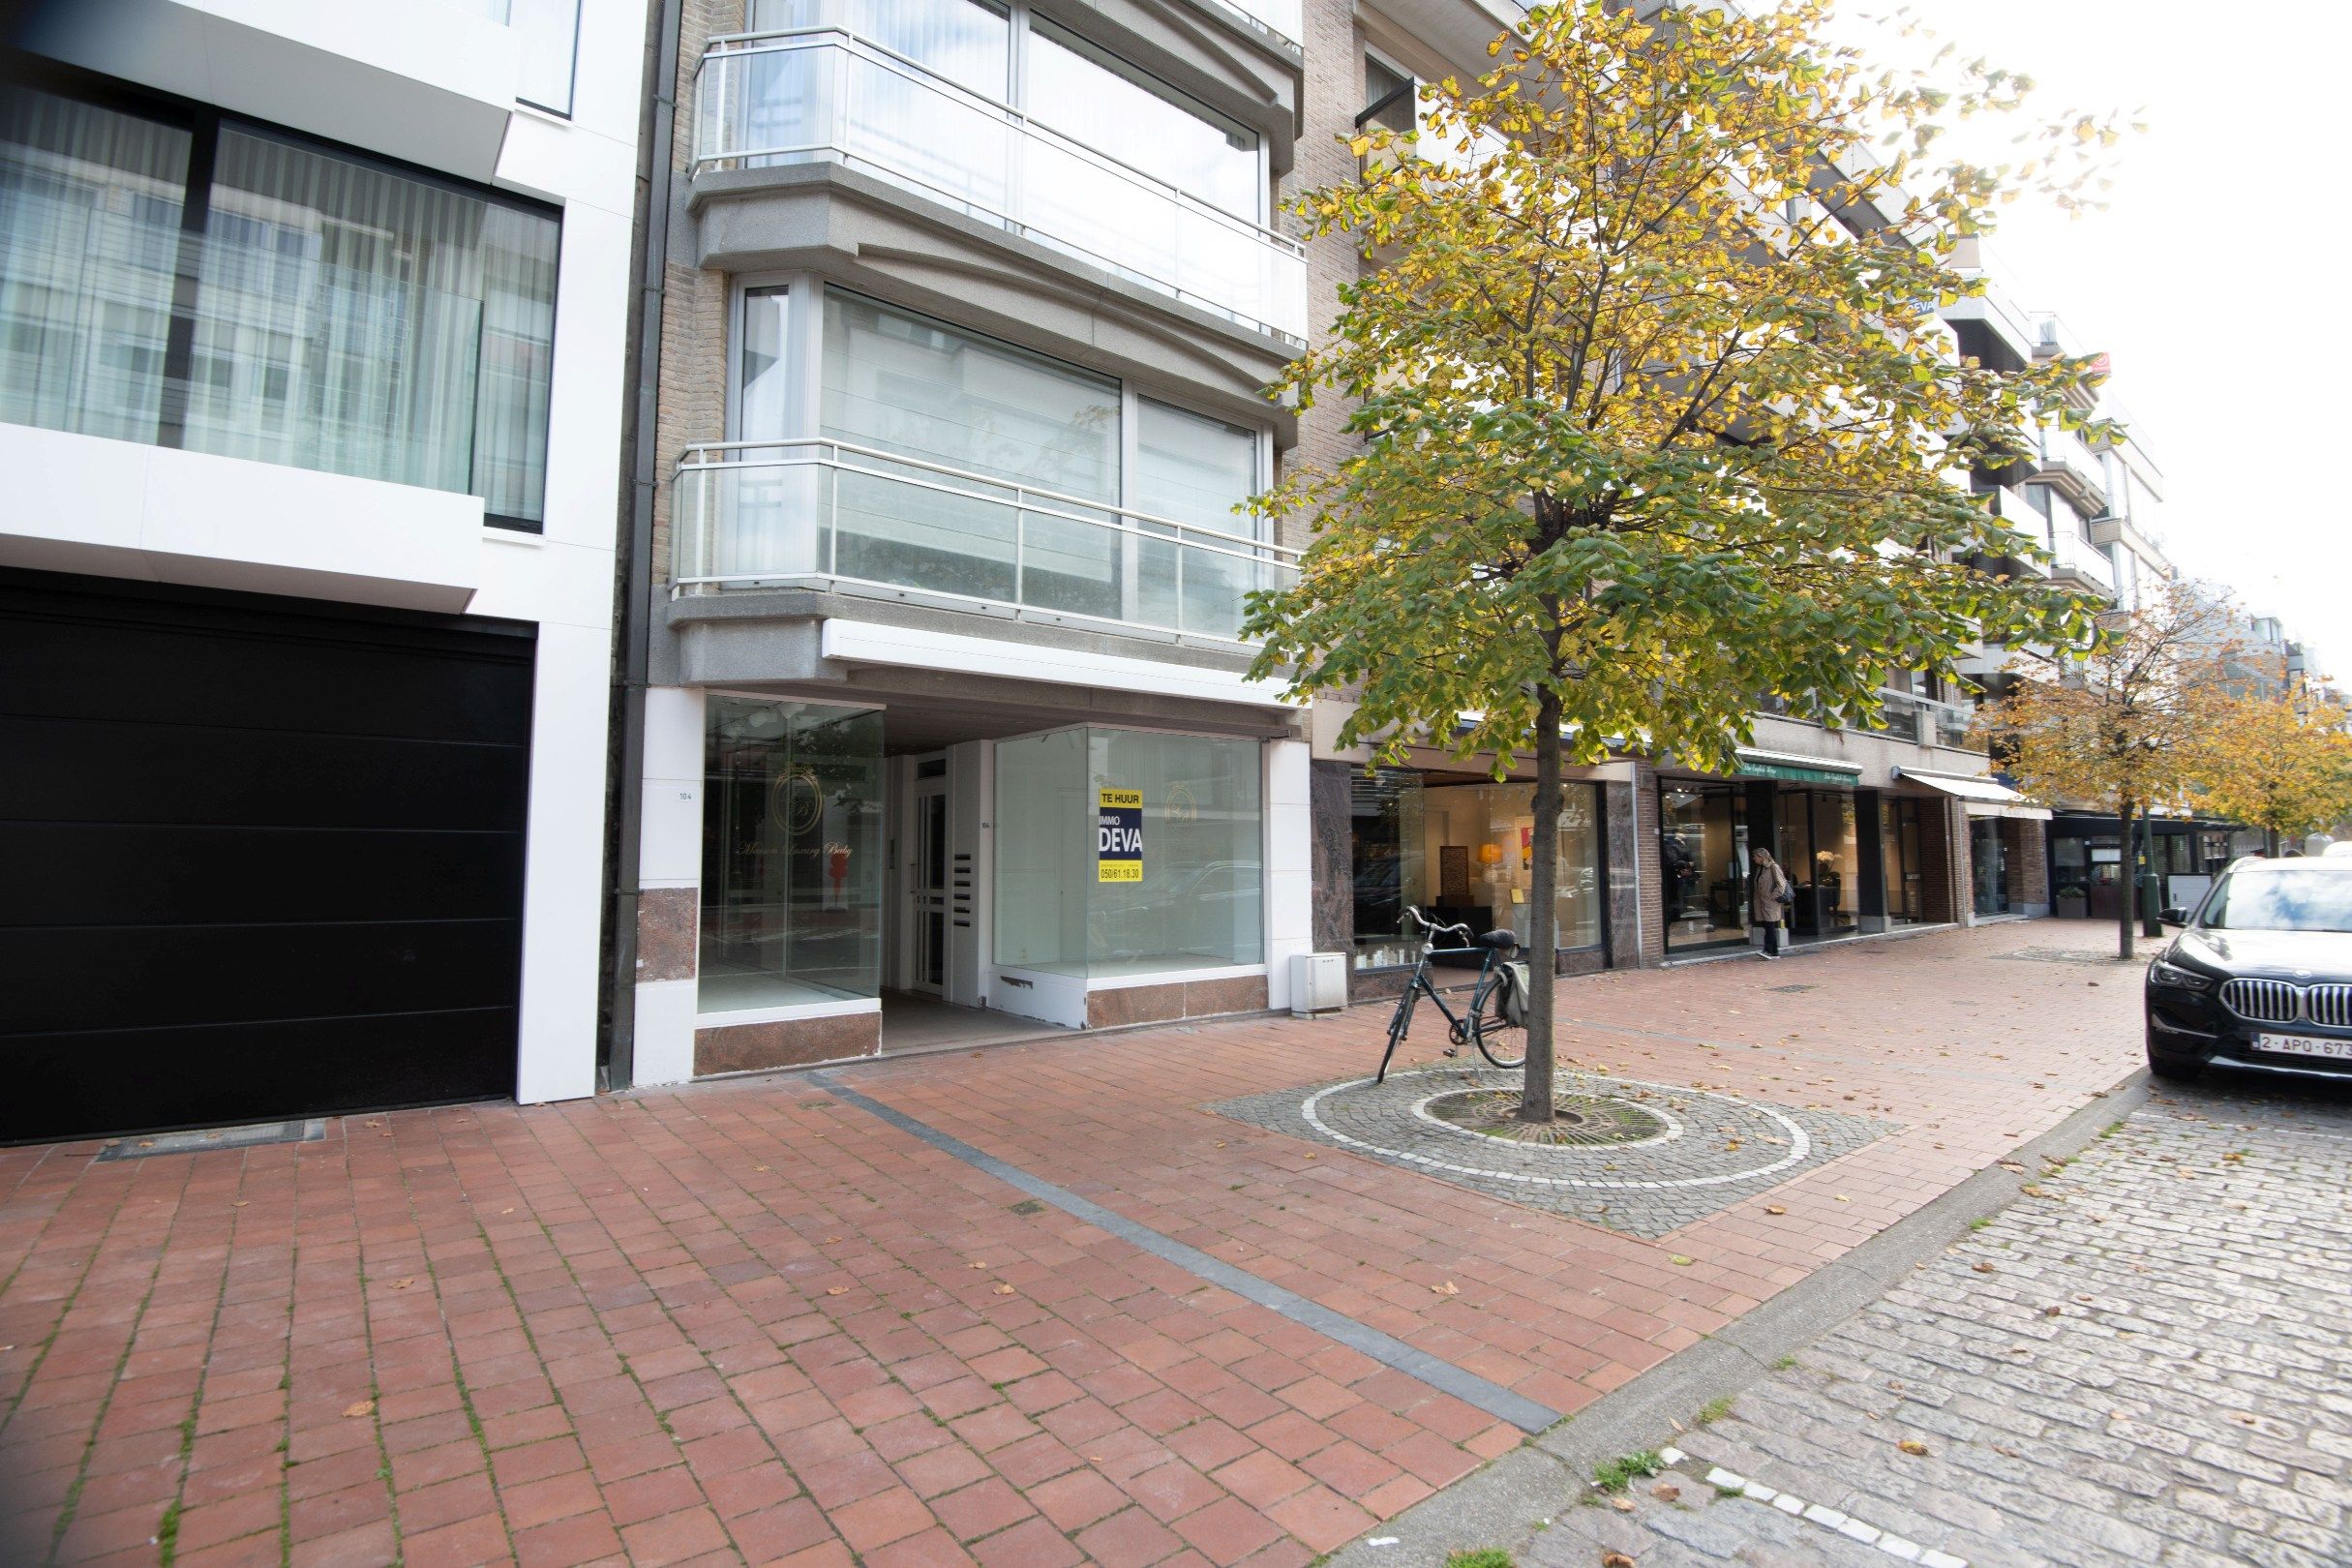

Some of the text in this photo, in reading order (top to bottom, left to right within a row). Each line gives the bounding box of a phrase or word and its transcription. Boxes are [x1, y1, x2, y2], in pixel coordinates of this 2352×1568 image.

[1101, 794, 1139, 803] TE HUUR
[1099, 816, 1120, 826] IMMO
[1099, 828, 1142, 852] DEVA
[823, 841, 852, 859] Baby
[1101, 868, 1139, 879] 050/61.18.30
